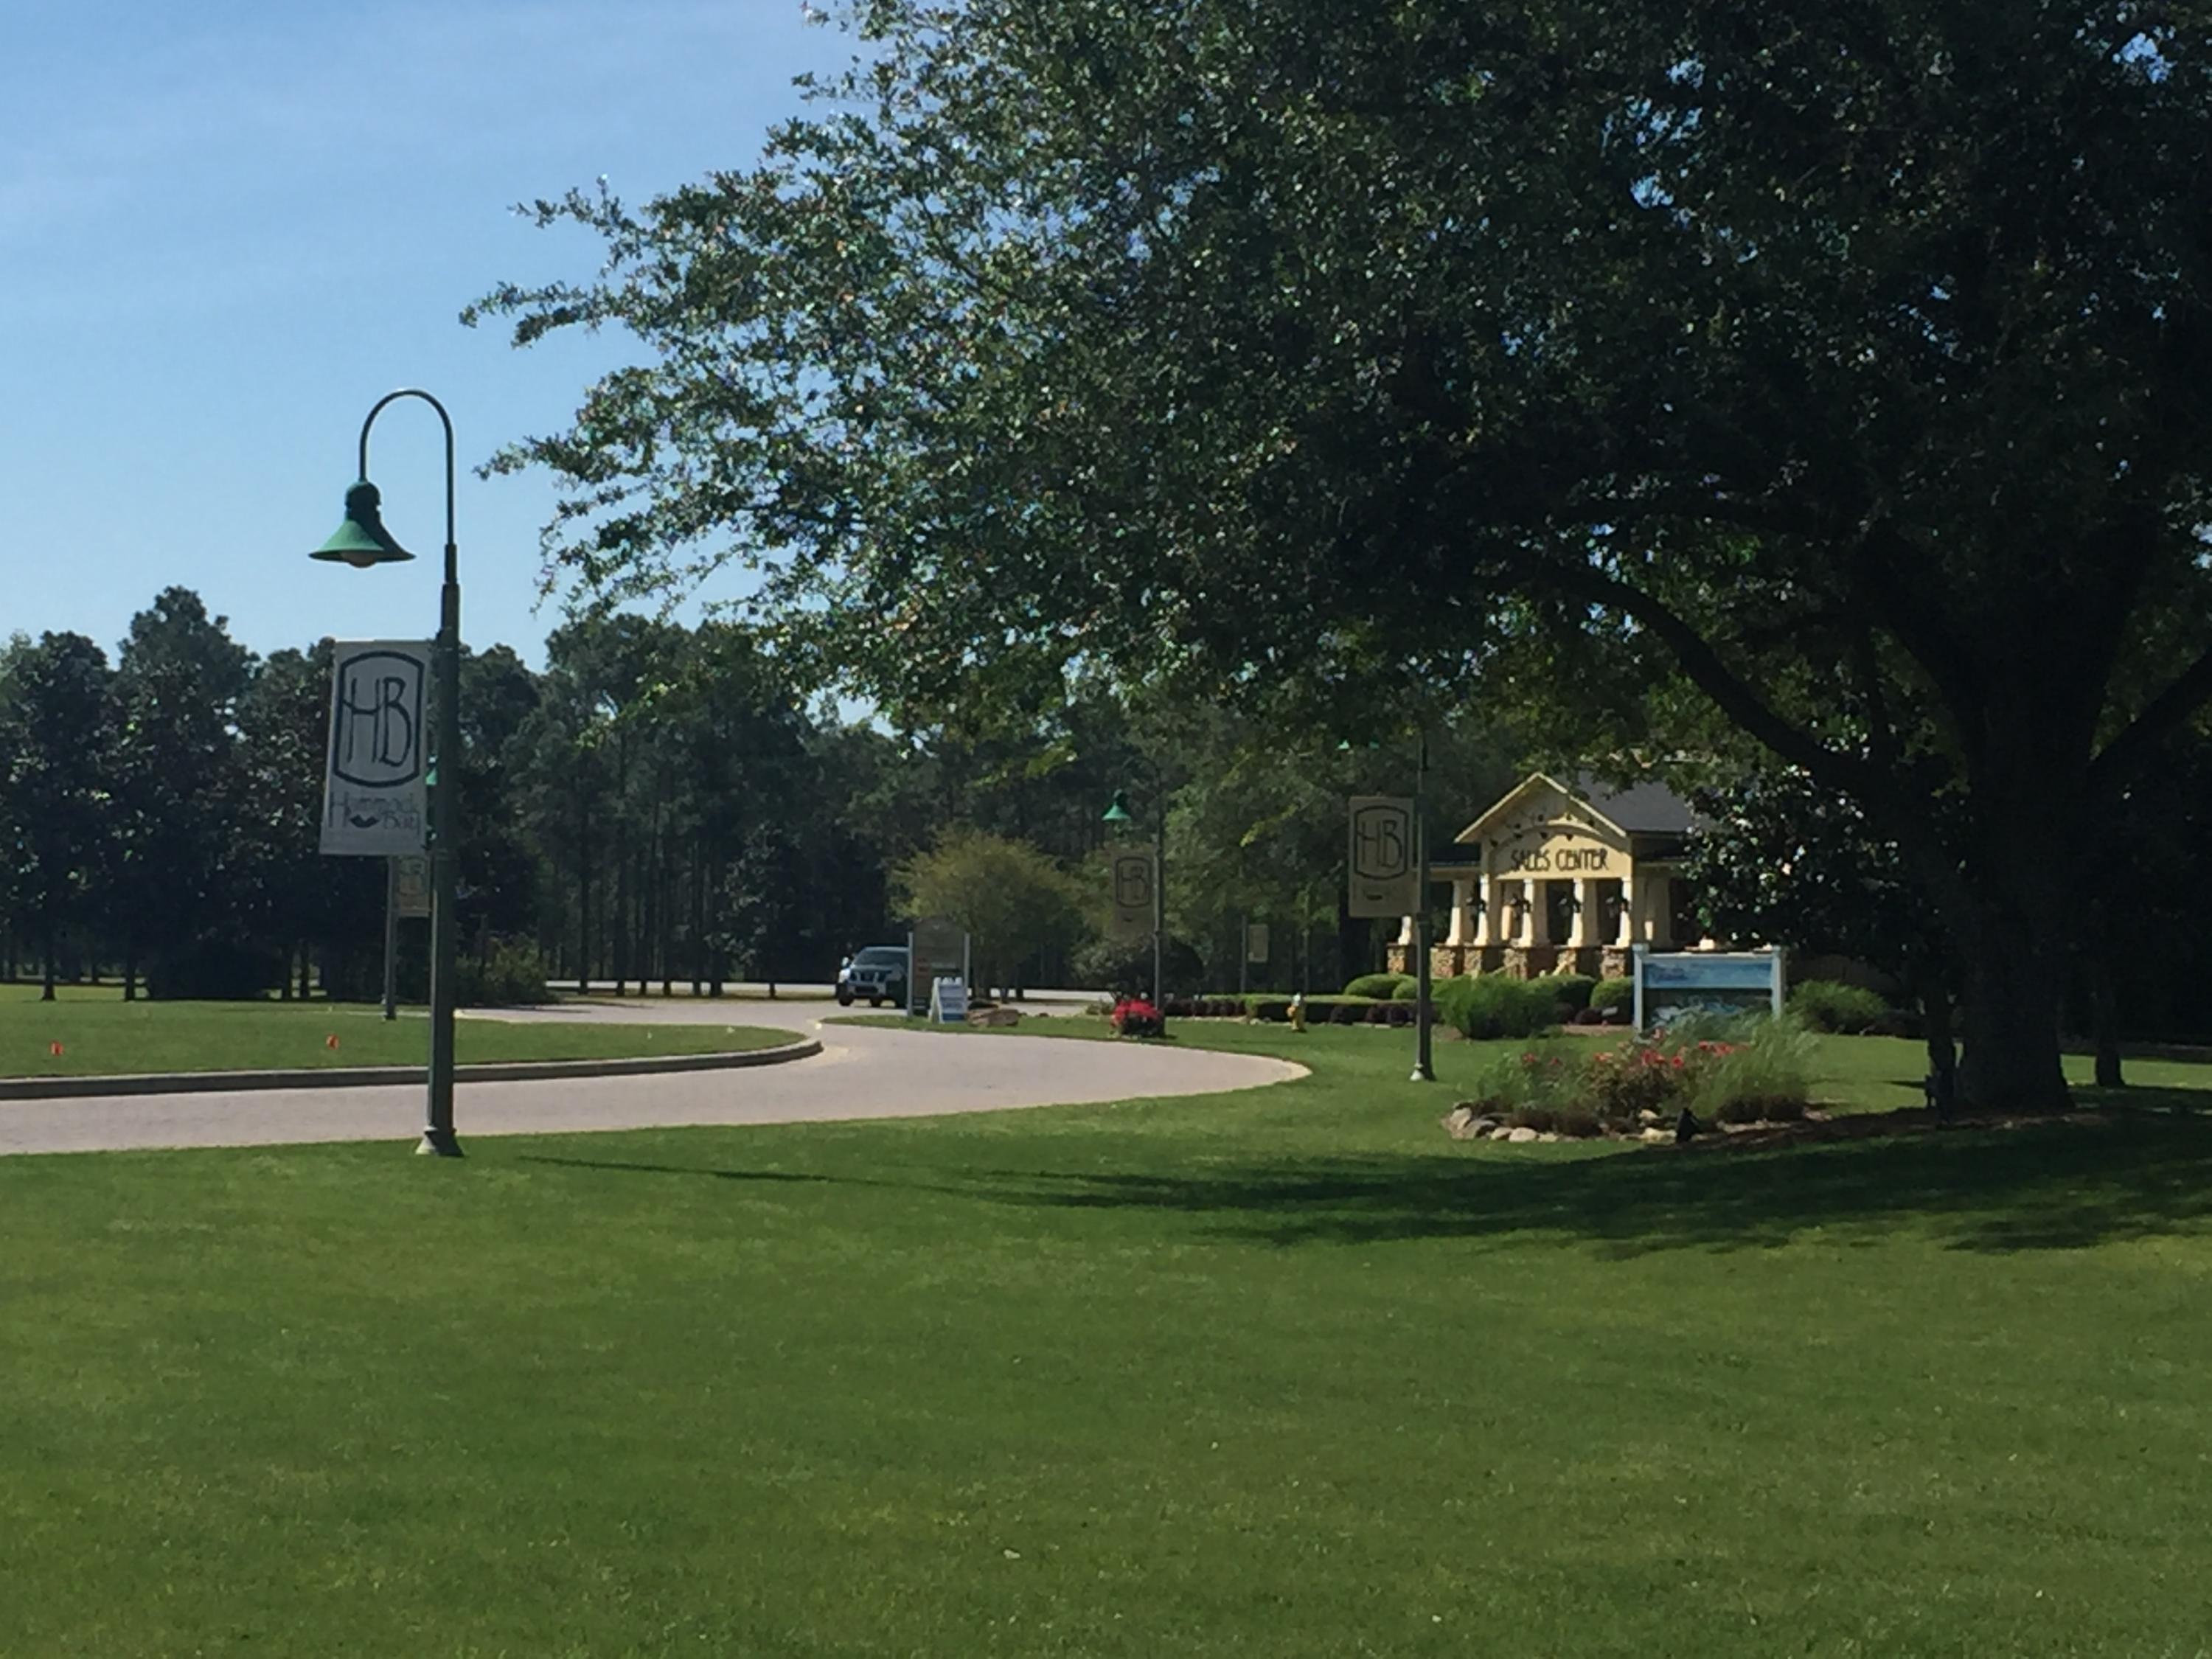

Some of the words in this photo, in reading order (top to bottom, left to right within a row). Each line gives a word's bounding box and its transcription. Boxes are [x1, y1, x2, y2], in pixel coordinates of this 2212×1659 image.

[344, 677, 411, 768] HB
[1355, 820, 1402, 868] HB
[1511, 849, 1551, 872] SALES
[1556, 849, 1610, 872] CENTER
